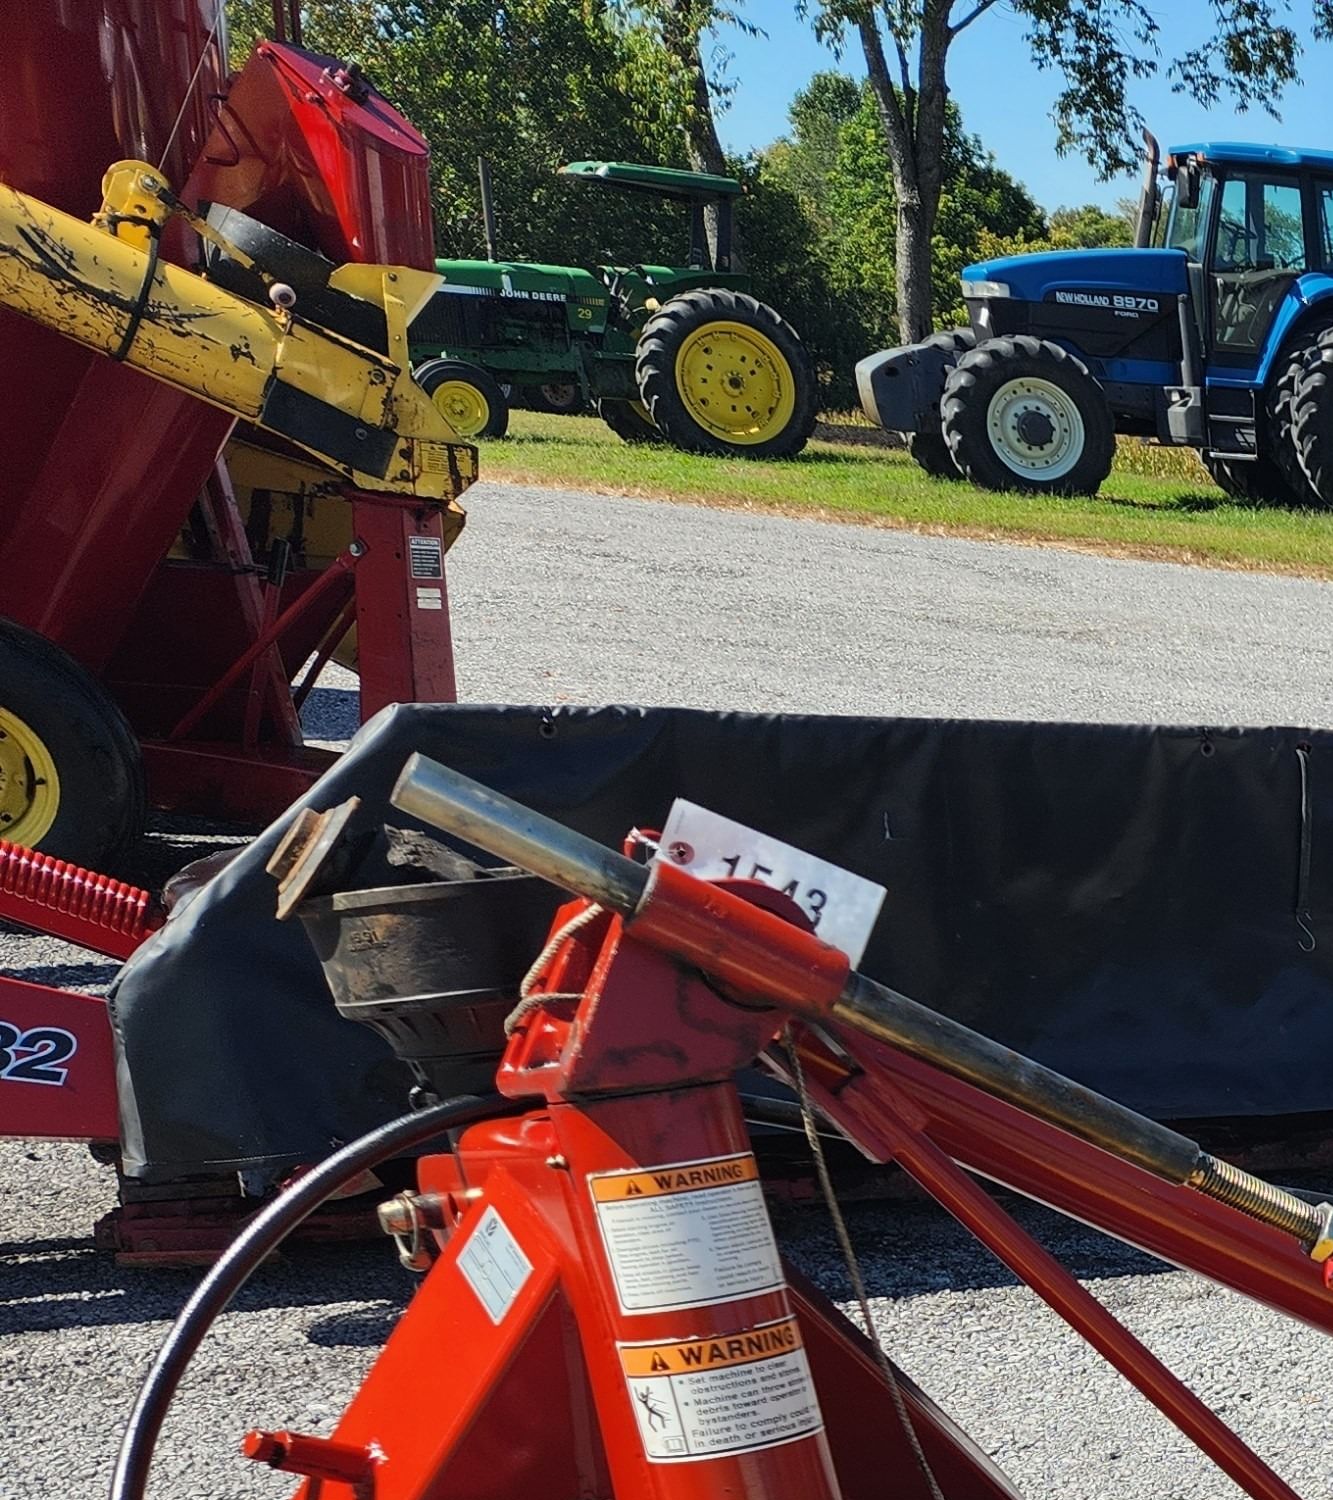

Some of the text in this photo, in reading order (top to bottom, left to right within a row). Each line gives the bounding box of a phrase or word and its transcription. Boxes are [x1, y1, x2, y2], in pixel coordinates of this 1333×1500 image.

[500, 289, 567, 302] JOHN DEERE
[1056, 291, 1158, 310] NEW HOLLAND 8970
[1114, 310, 1139, 318] FORD
[0, 1021, 77, 1086] 2
[653, 1164, 743, 1190] WARNING
[678, 1326, 795, 1366] WARNING
[688, 1377, 705, 1385] Set
[709, 1369, 752, 1381] machine
[691, 1378, 757, 1395] obstructions
[694, 1394, 738, 1406] Machine
[741, 1389, 758, 1398] can
[696, 1405, 730, 1415] debris
[732, 1397, 767, 1409] toward
[692, 1426, 731, 1438] Failure
[735, 1423, 747, 1431] to
[750, 1413, 787, 1428] comply
[709, 1434, 741, 1446] death
[744, 1432, 757, 1440] or
[760, 1423, 796, 1436] serious
